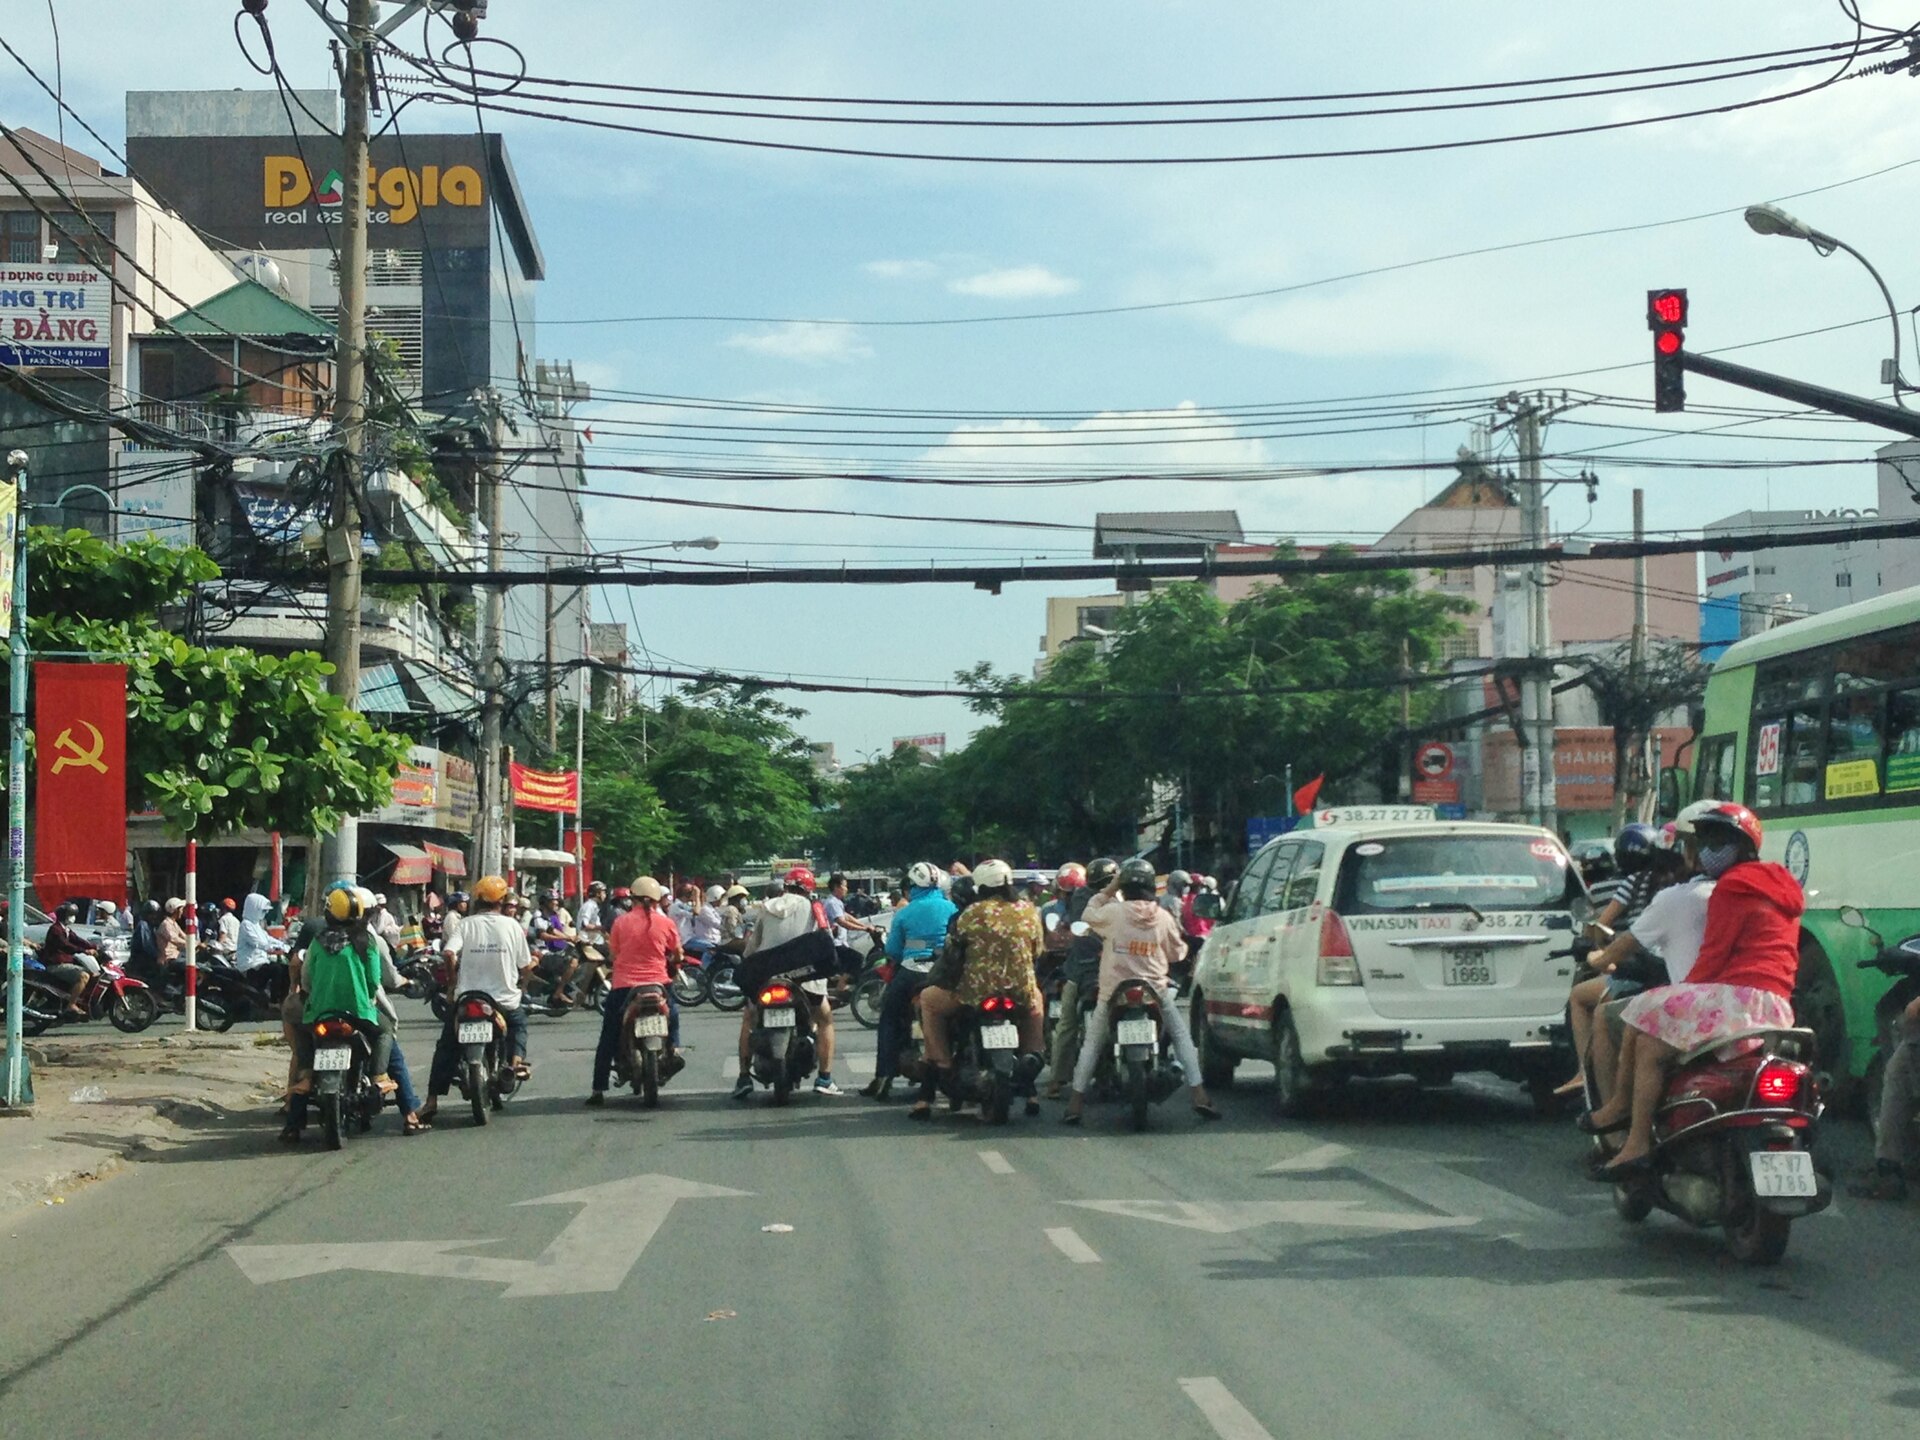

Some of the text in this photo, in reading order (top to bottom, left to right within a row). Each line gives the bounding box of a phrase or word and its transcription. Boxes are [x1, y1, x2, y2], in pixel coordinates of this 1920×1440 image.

[264, 209, 390, 224] real este
[8, 271, 44, 283] DỤNG
[47, 272, 64, 284] CỤ
[66, 270, 98, 285] ĐIỆN
[0, 290, 35, 308] NG
[1760, 726, 1780, 772] 95
[1344, 809, 1387, 822] 38.27
[1392, 809, 1409, 821] 27
[1414, 809, 1432, 821] 27
[1485, 914, 1533, 928] 38.27
